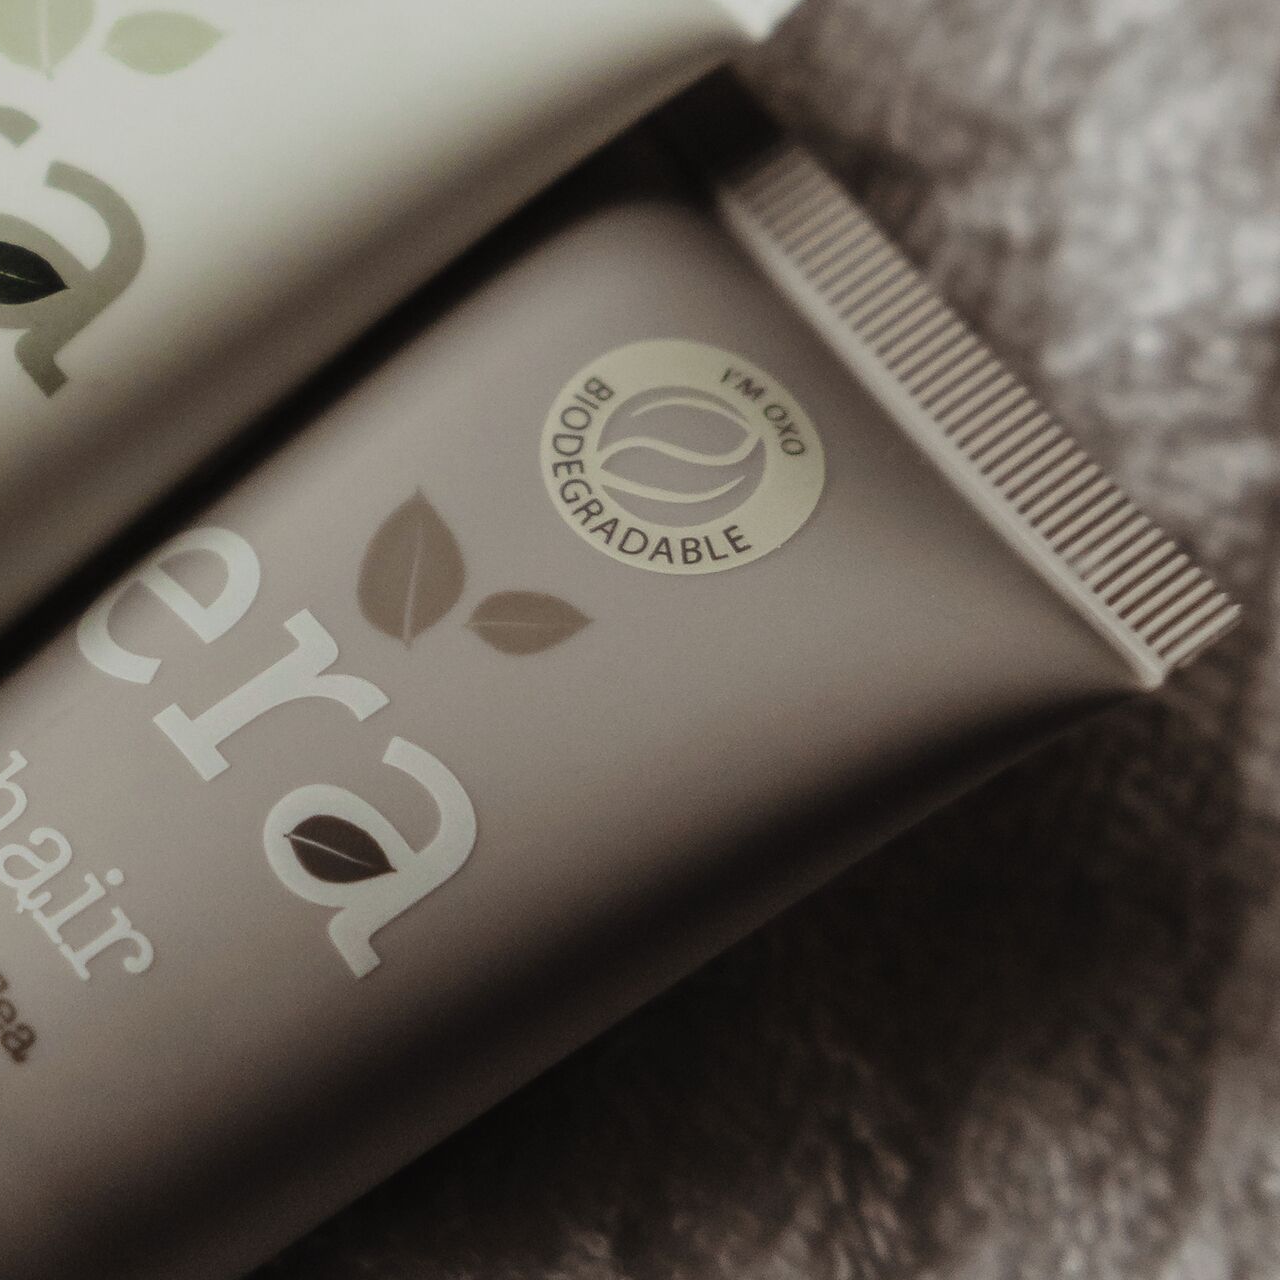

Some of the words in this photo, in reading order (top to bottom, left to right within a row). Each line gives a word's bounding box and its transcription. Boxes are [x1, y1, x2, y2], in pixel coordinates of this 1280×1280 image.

[551, 376, 752, 565] BIODEGRADABLE
[763, 403, 806, 457] OXO
[76, 524, 477, 979] era
